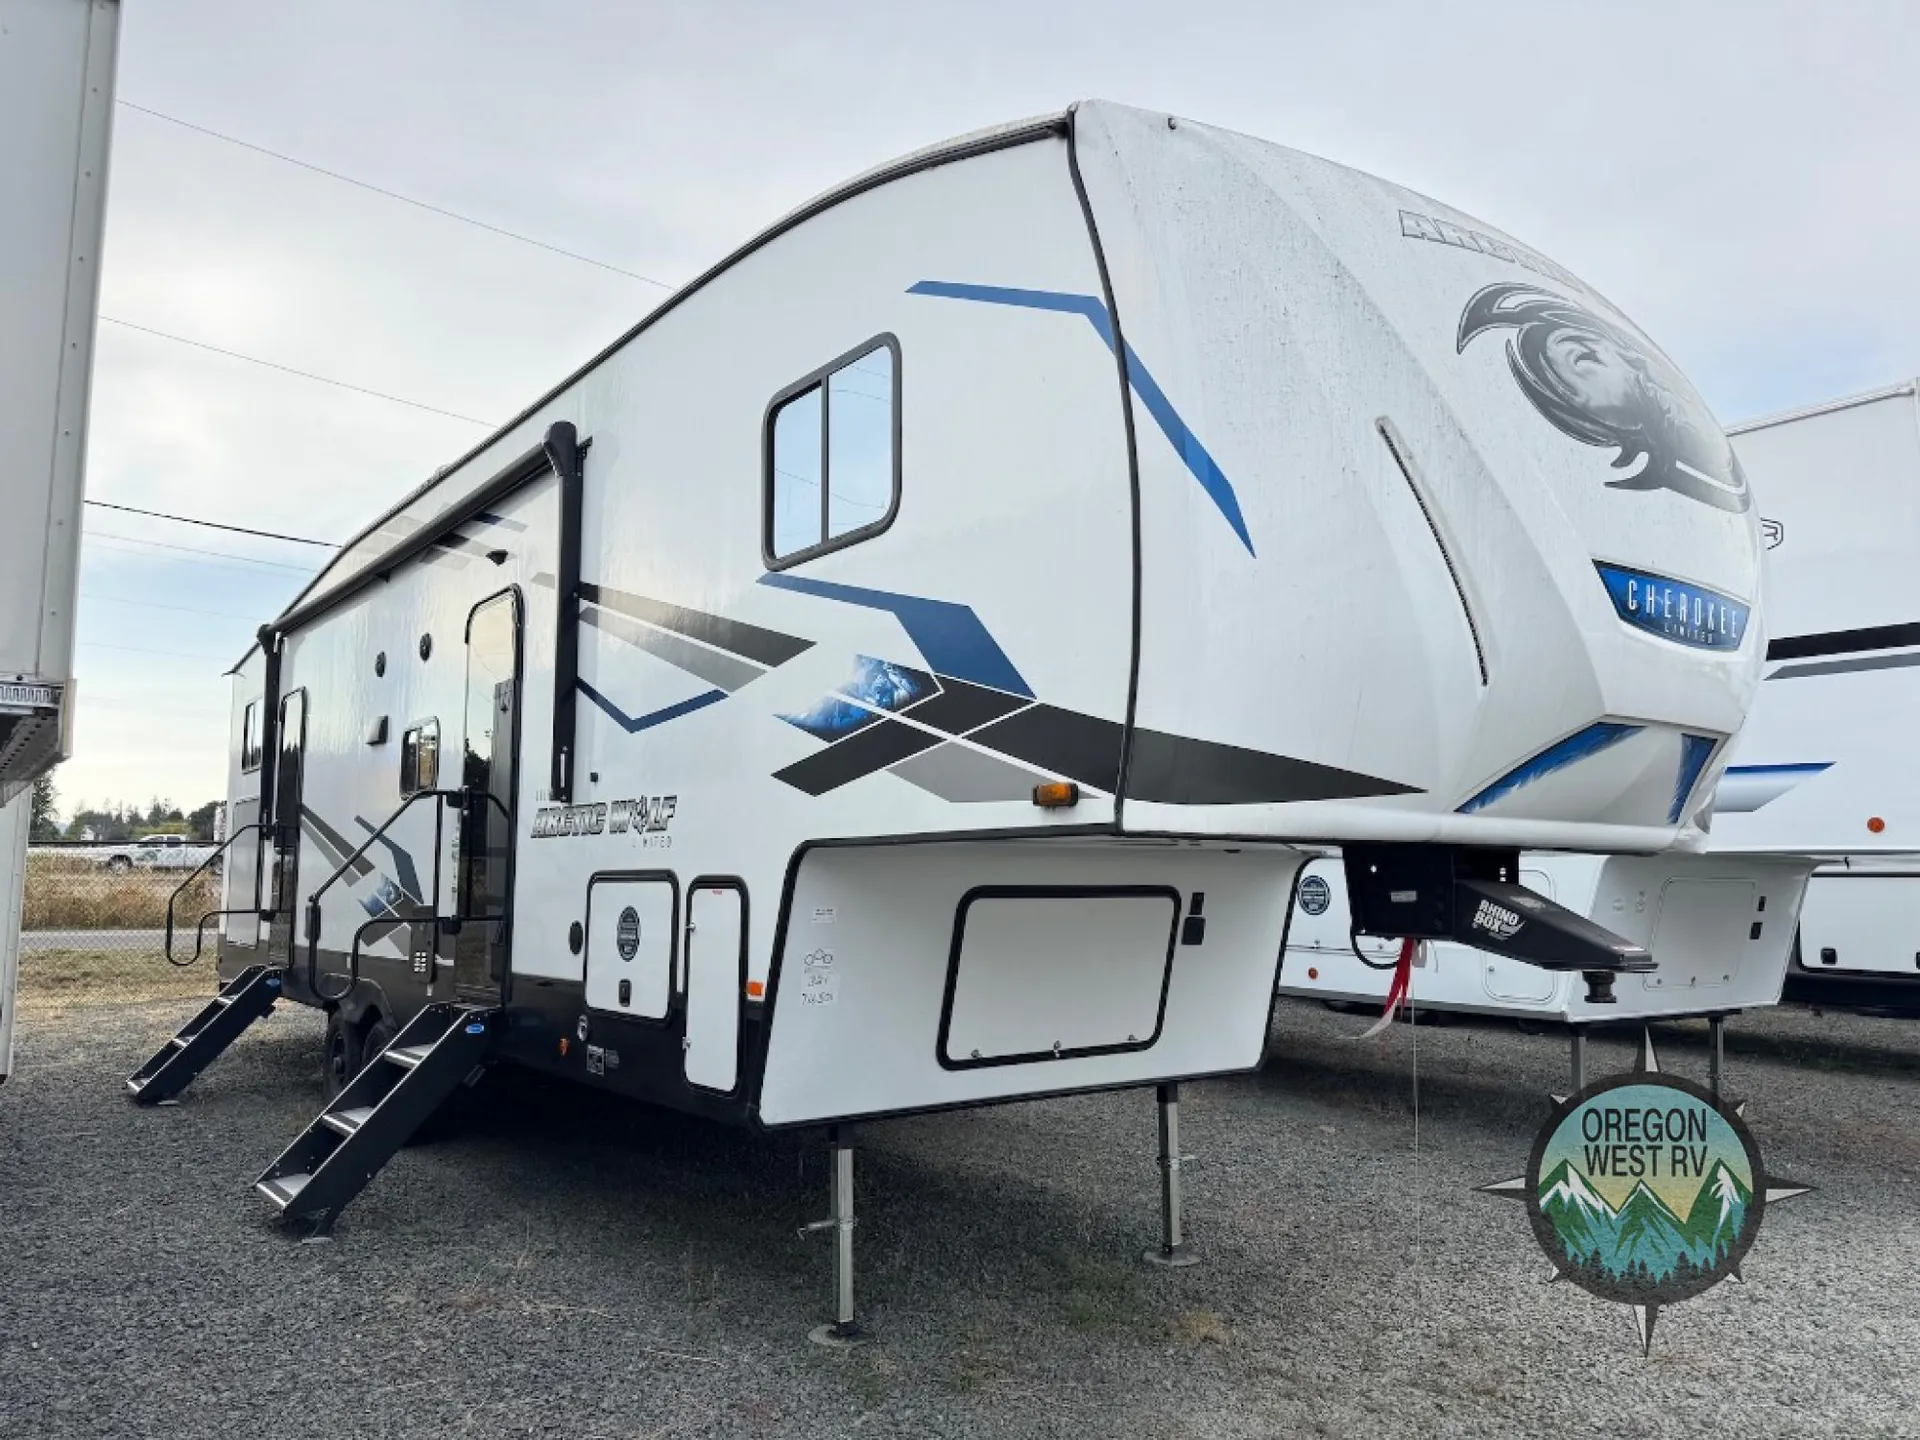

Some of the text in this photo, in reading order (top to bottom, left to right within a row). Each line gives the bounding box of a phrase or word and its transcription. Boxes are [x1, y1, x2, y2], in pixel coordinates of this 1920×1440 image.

[1628, 580, 1737, 638] CHEROKEE
[1665, 623, 1713, 643] LIMITED
[531, 802, 607, 838] ARCTIC
[1474, 912, 1502, 932] BOX
[1479, 899, 1520, 926] RHINO
